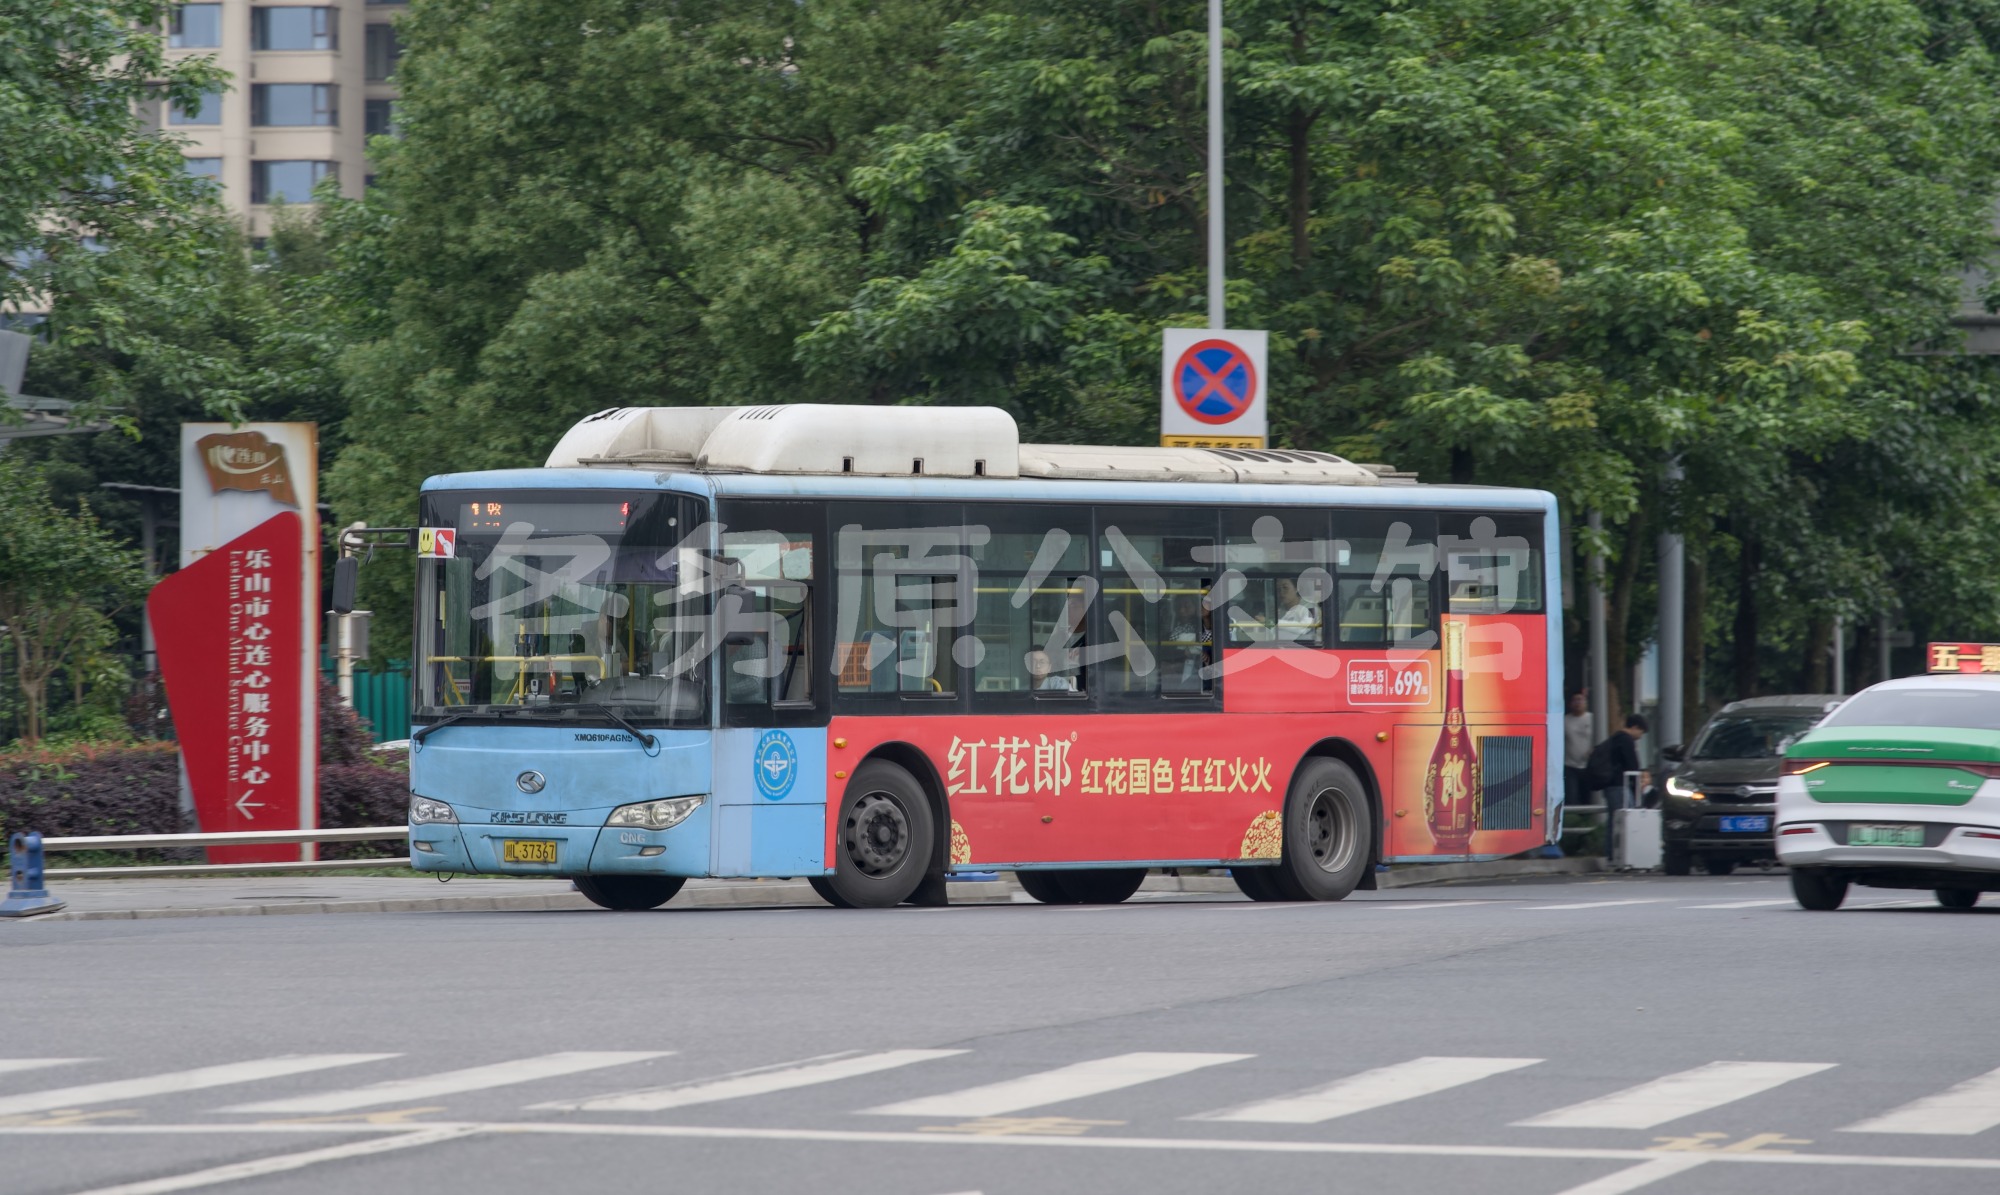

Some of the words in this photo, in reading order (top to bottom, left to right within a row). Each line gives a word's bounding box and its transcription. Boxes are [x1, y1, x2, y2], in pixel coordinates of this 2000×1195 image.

[229, 550, 244, 599] Leshan
[229, 603, 244, 631] One
[229, 637, 244, 673] Mind
[242, 548, 272, 785] 乐山市心连心服务中心
[228, 679, 243, 730] Service
[228, 735, 243, 782] Center
[947, 733, 1072, 796] 红花郎
[1080, 757, 1174, 795] 红花国色
[1180, 756, 1273, 794] 红红火火
[620, 832, 646, 844] CNG
